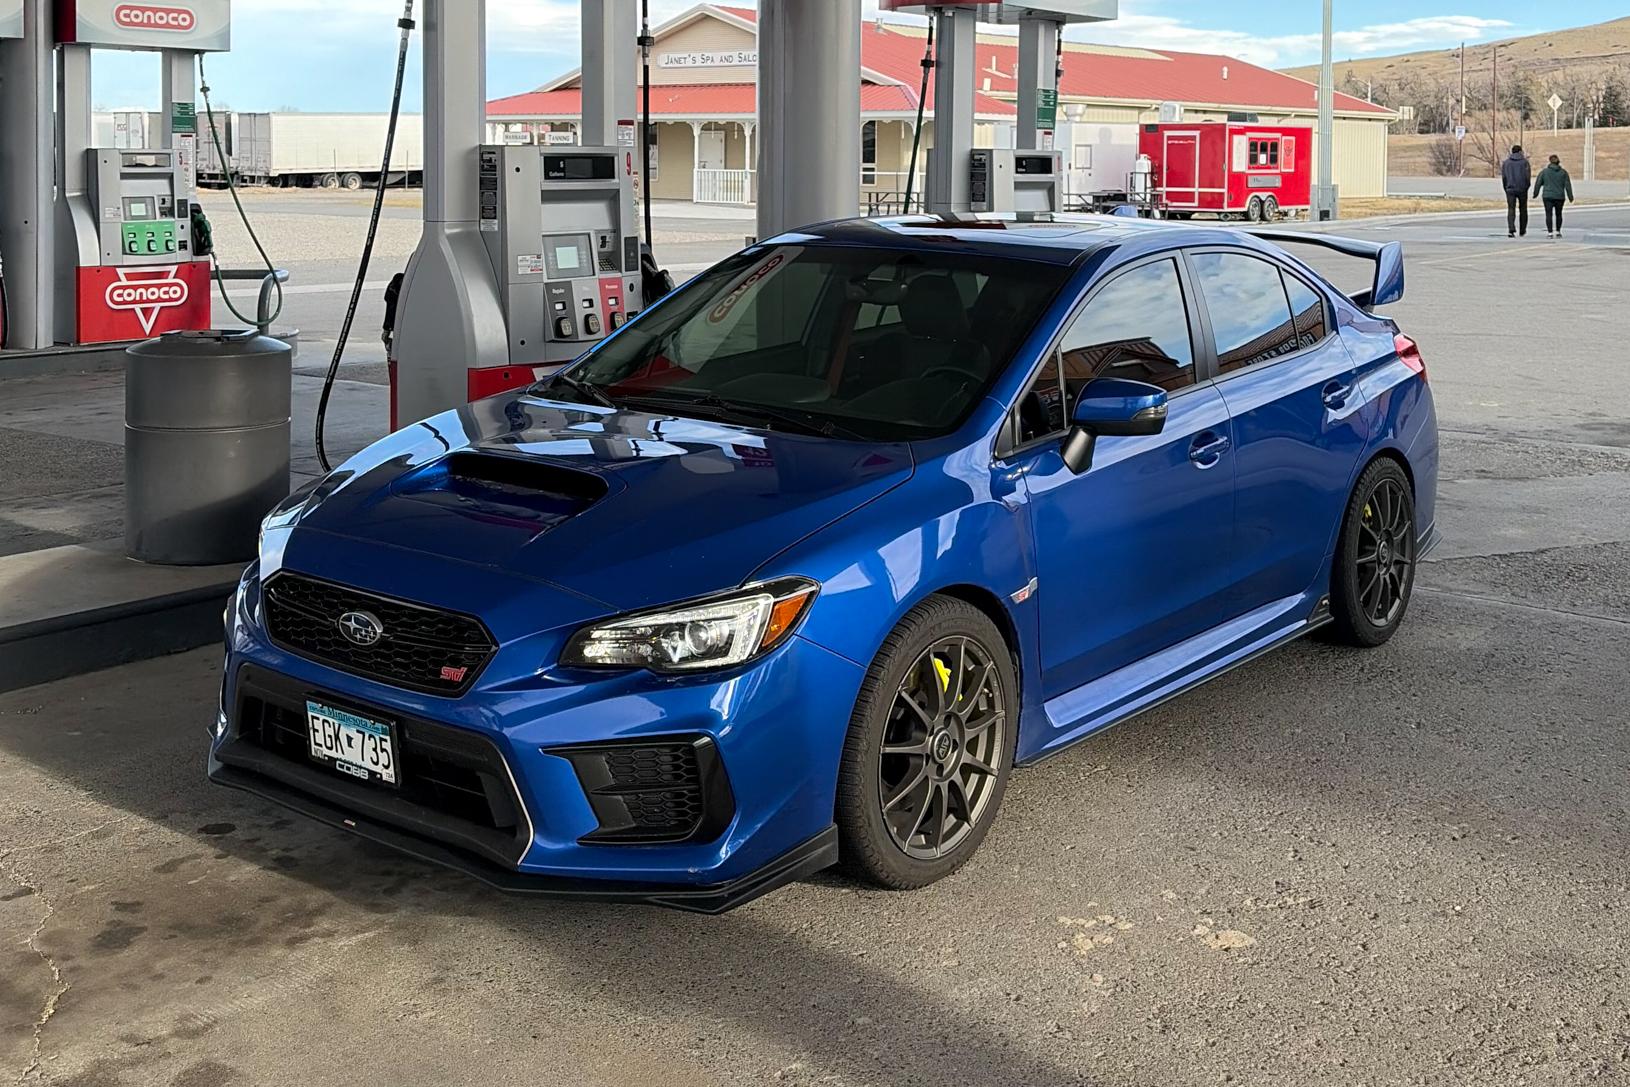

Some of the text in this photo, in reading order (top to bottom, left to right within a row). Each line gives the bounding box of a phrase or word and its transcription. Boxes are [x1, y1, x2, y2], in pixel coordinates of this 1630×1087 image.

[119, 9, 190, 26] conoco
[549, 134, 570, 142] TANNING
[626, 151, 632, 176] 9
[112, 286, 181, 302] conoco
[310, 714, 391, 770] EGK 735
[336, 760, 369, 780] COBB
